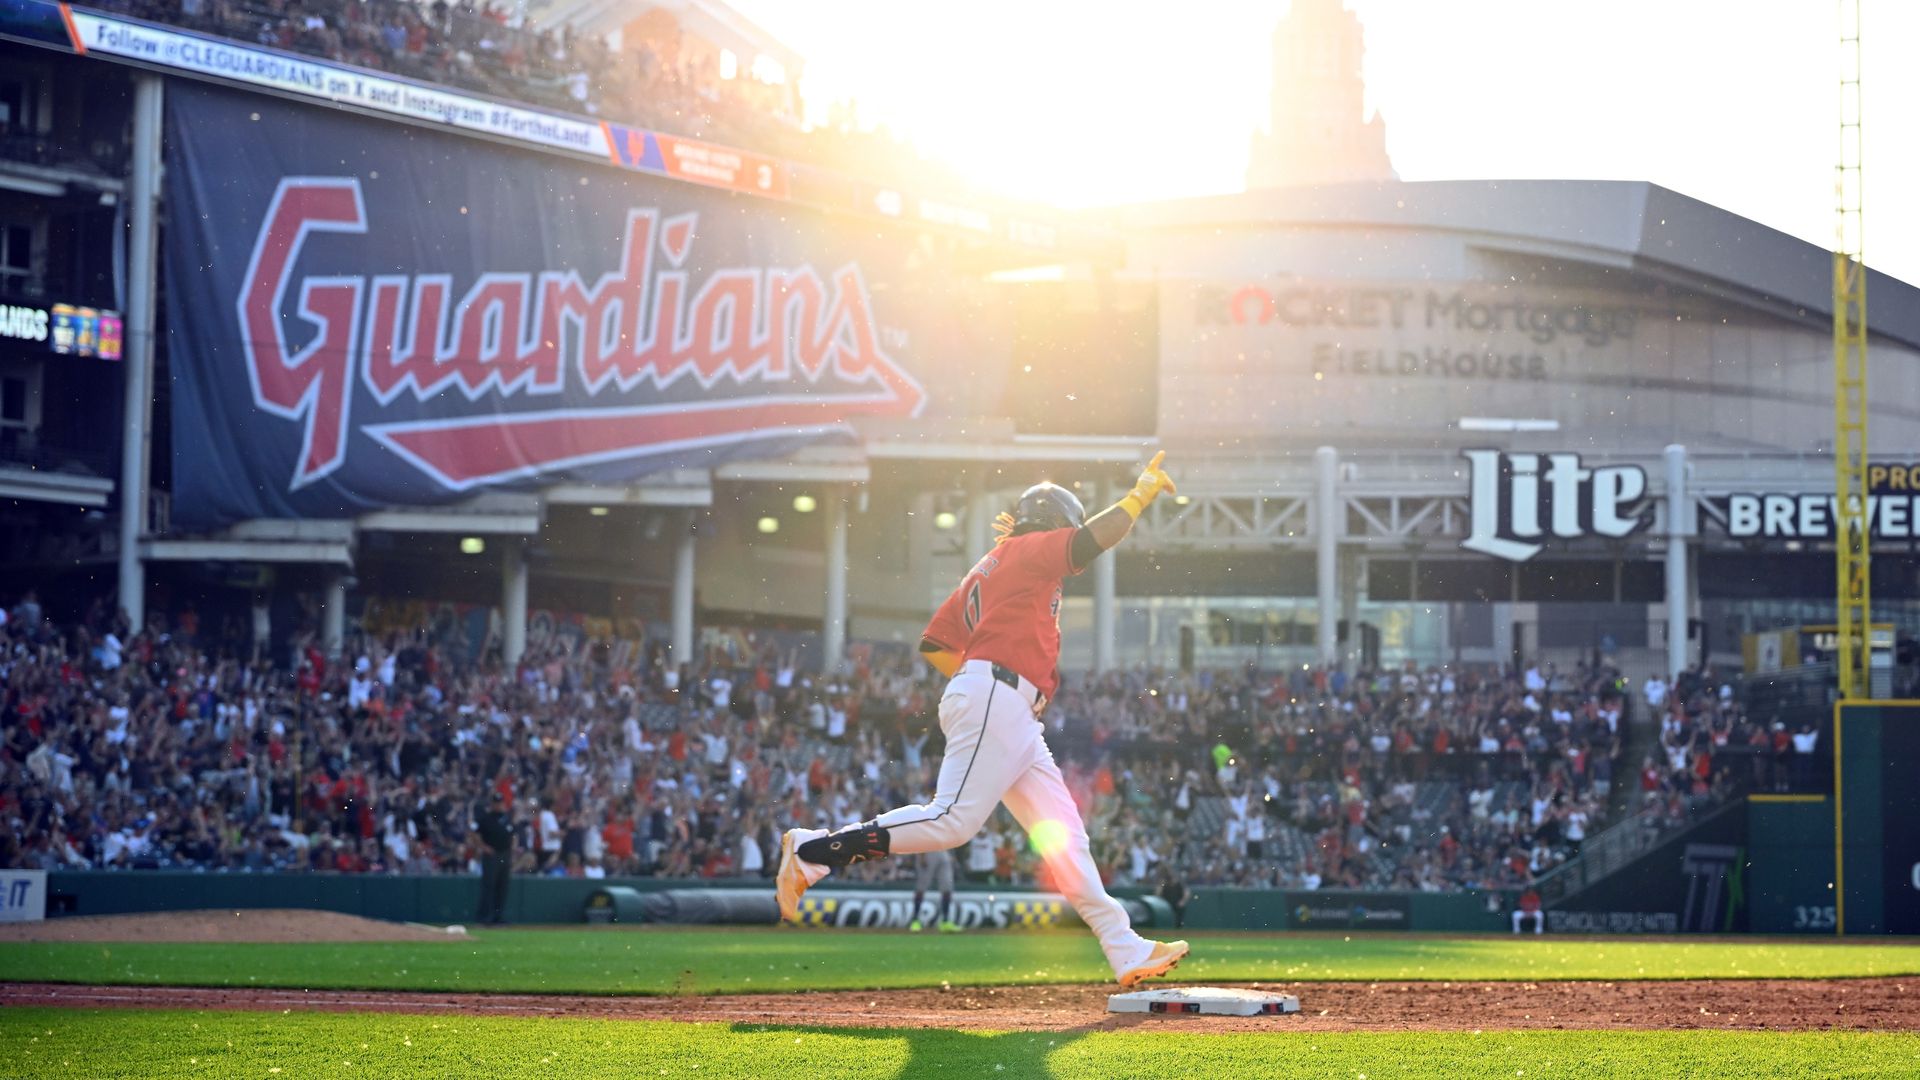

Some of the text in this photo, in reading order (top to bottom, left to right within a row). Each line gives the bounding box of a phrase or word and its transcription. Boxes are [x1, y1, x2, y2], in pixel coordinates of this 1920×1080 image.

[98, 25, 592, 146] Follow @CLEGUARDIANS on X and Instagram #FortheLand
[757, 164, 772, 189] 3
[236, 176, 926, 492] Guardians
[1197, 286, 1637, 347] ROCKET Mortgage
[1460, 448, 1645, 562] Lite
[1729, 494, 1920, 537] BREWE
[9, 879, 32, 907] IT
[1793, 904, 1836, 929] 325
